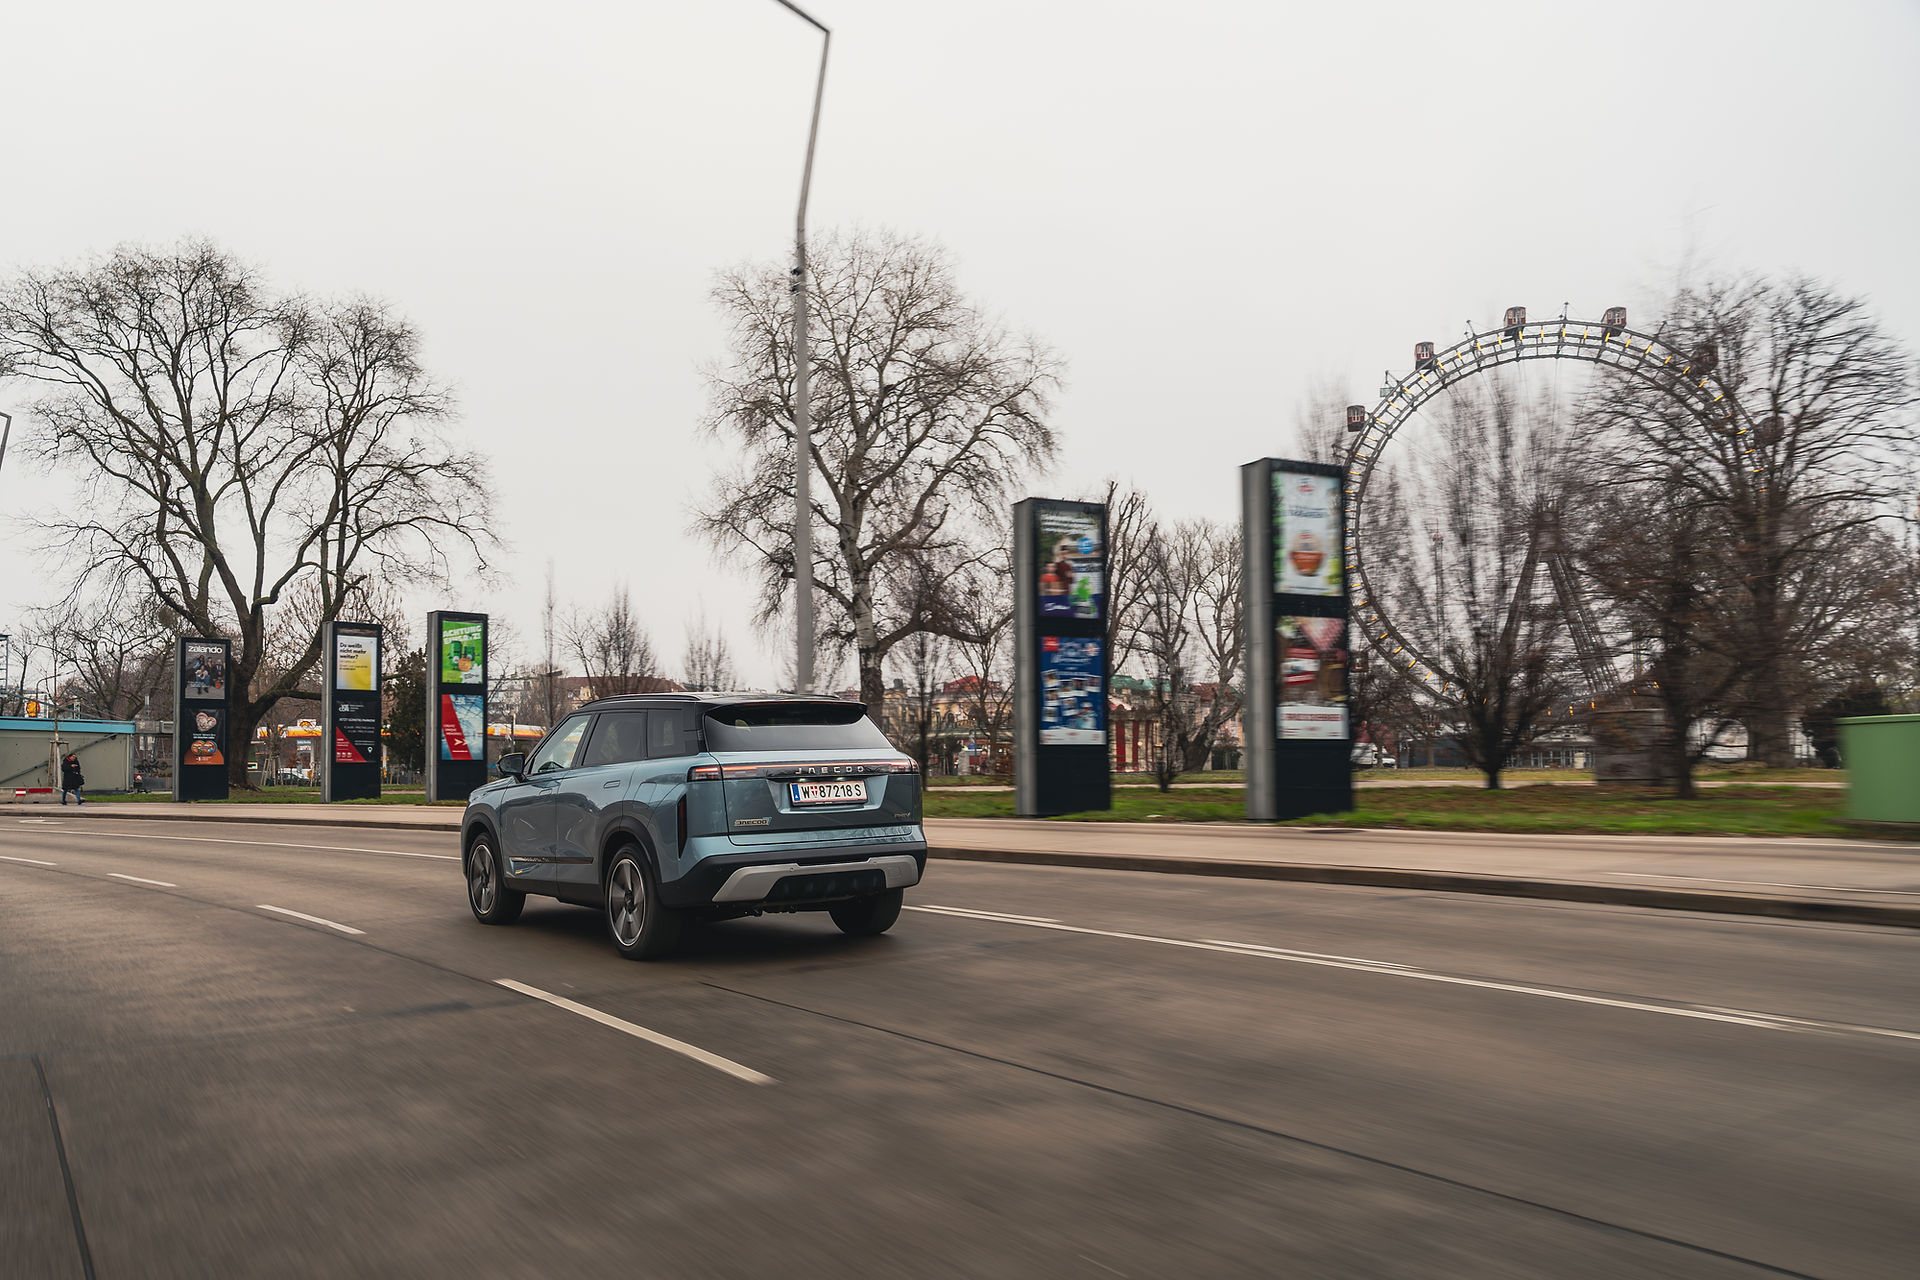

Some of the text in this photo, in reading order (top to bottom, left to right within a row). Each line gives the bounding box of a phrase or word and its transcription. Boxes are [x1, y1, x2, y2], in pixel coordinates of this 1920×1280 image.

[443, 625, 482, 637] ACHTUNG
[188, 645, 223, 654] zalando
[795, 765, 864, 774] JAECOO
[801, 785, 810, 799] W
[819, 784, 852, 798] 87218
[854, 784, 862, 796] S
